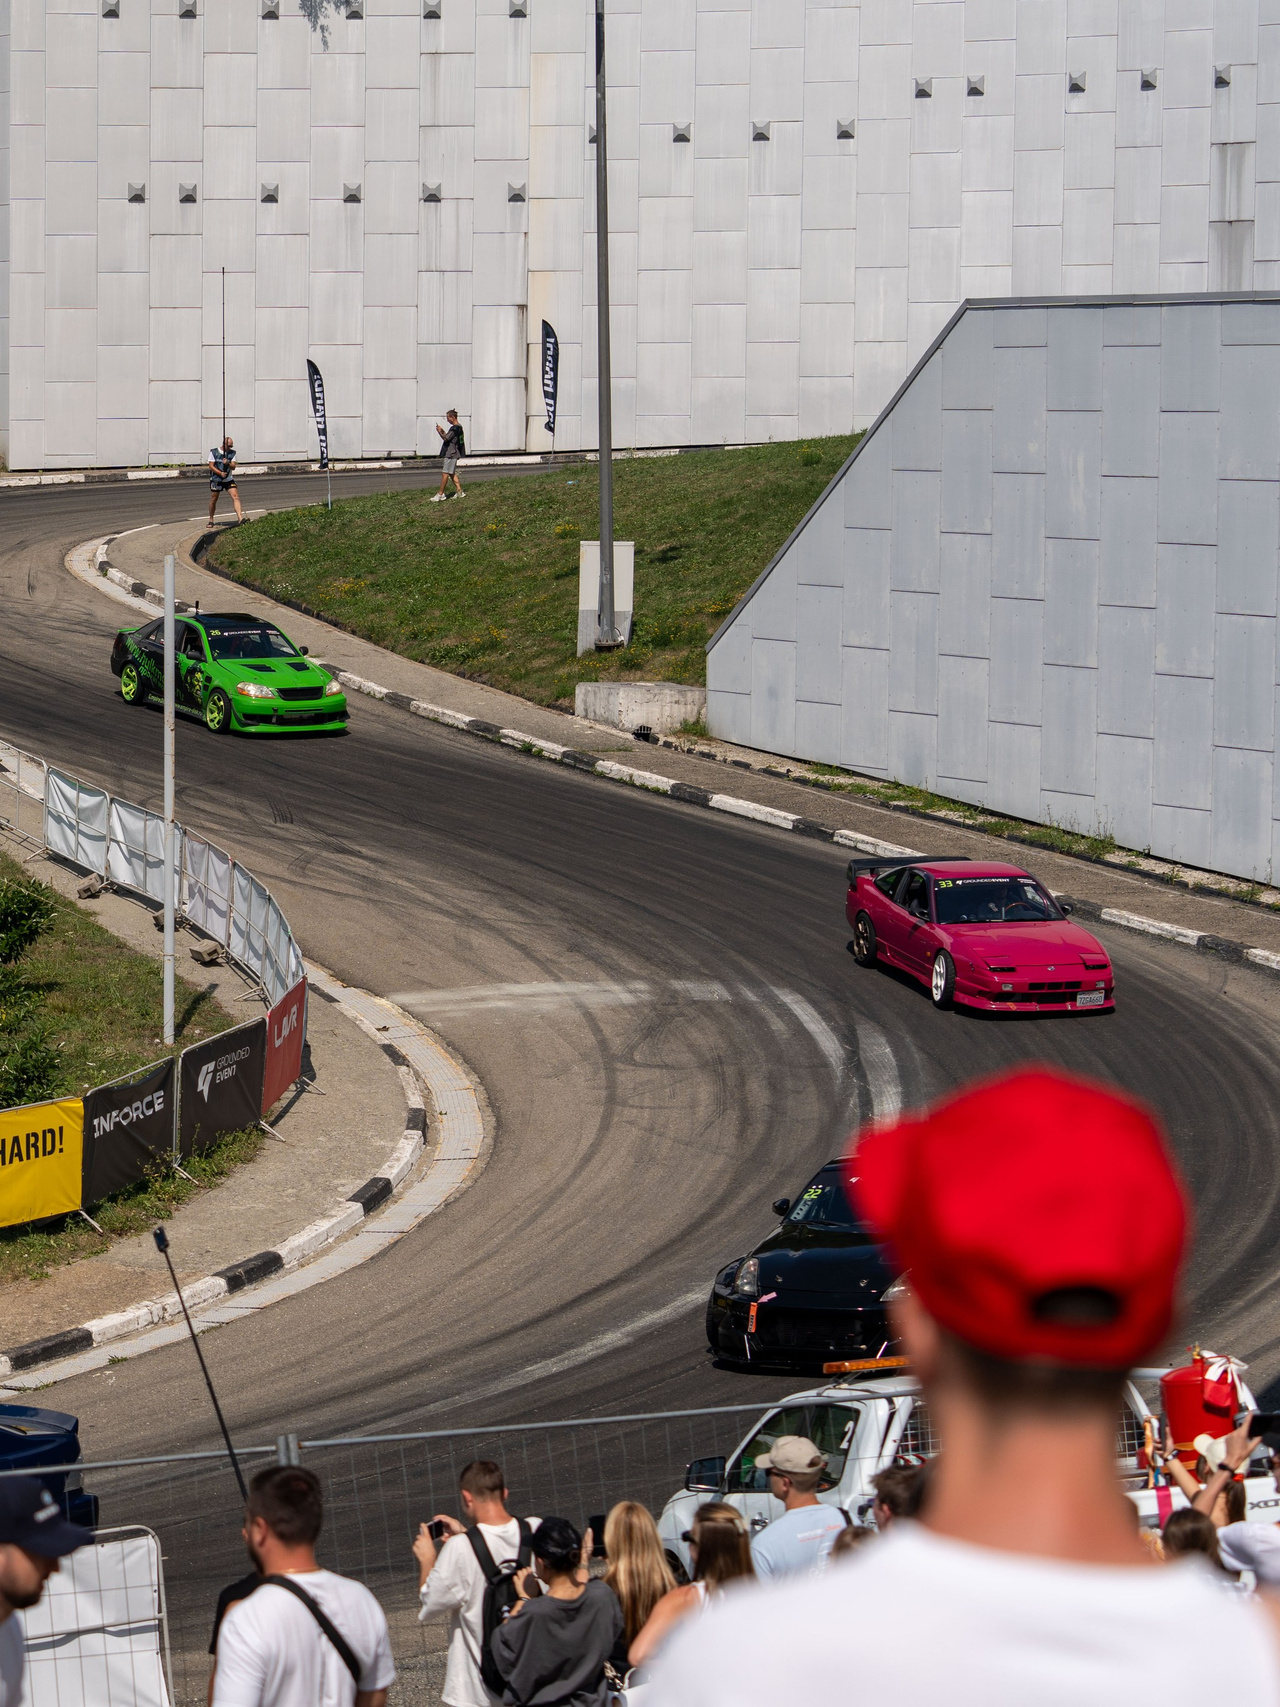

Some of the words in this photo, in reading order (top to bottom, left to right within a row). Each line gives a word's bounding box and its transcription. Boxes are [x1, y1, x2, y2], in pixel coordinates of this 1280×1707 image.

[939, 880, 953, 888] 33
[274, 1004, 297, 1048] LAVR
[216, 1046, 251, 1069] GROUNDED
[215, 1065, 237, 1083] EVENT
[93, 1089, 164, 1138] INFORCE
[803, 1188, 822, 1199] 22
[840, 1421, 854, 1448] 2
